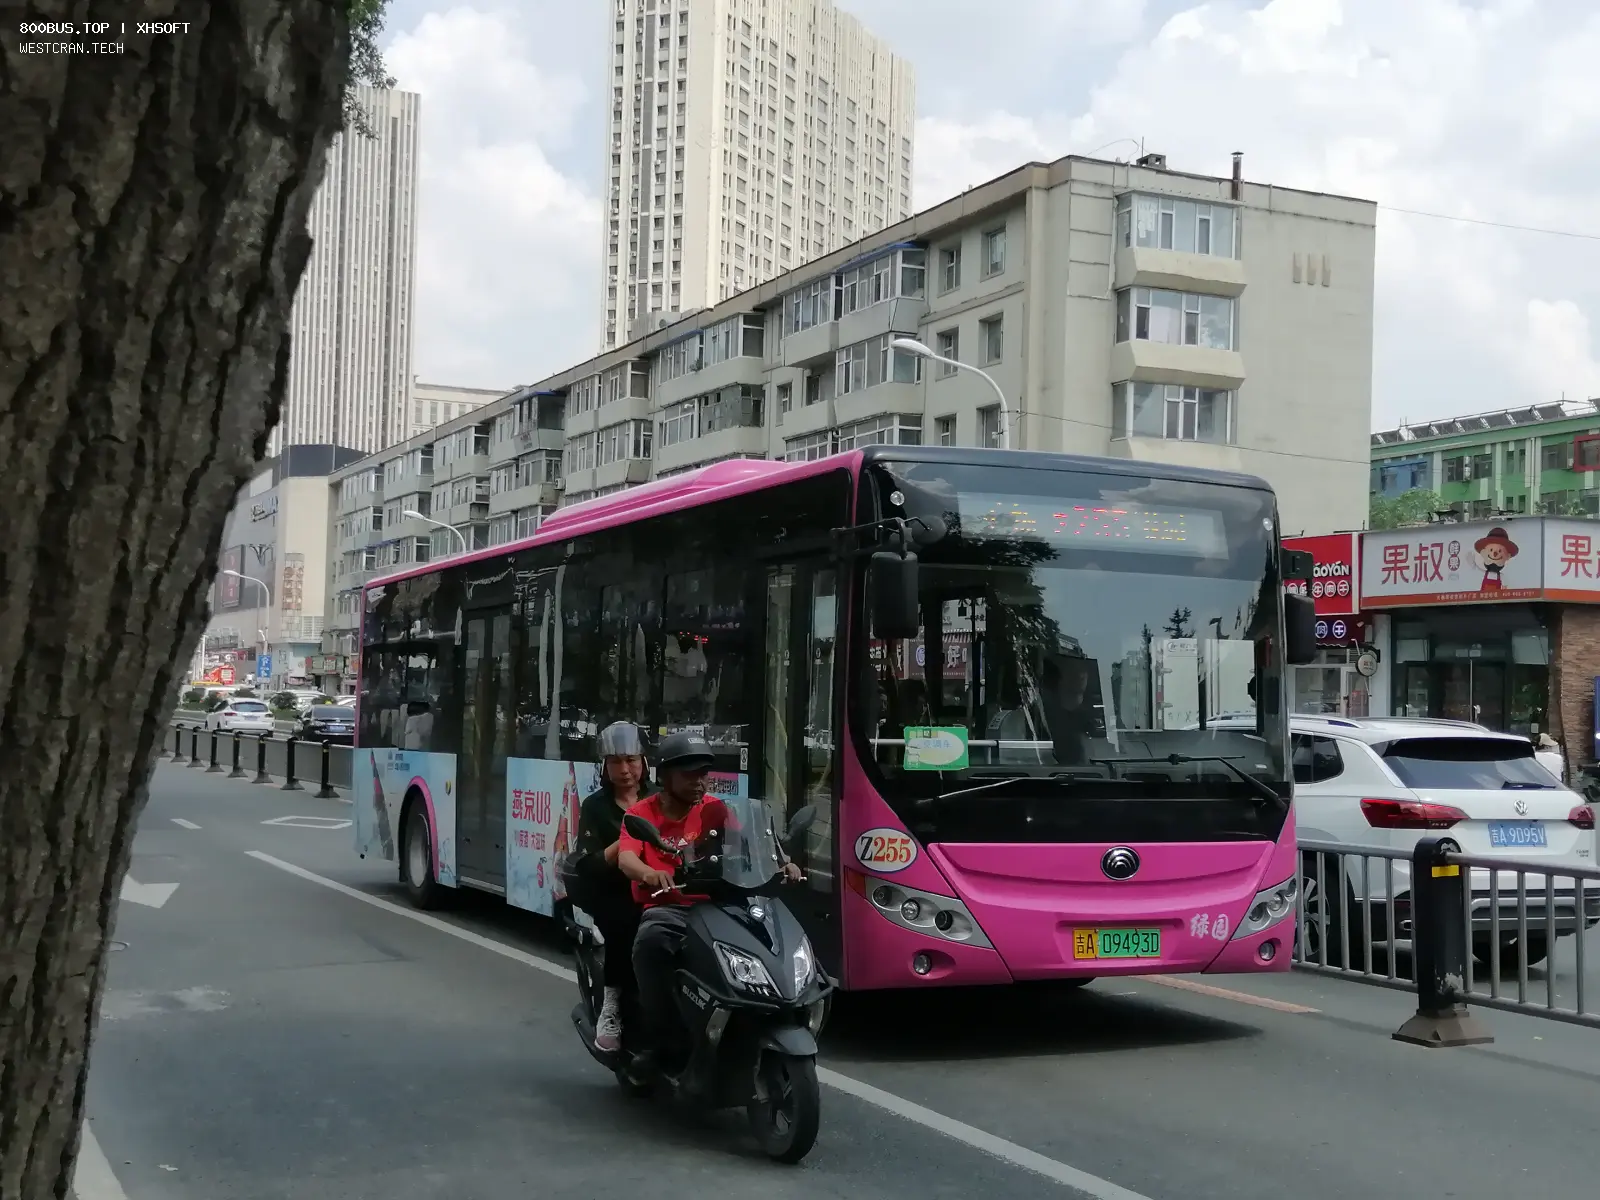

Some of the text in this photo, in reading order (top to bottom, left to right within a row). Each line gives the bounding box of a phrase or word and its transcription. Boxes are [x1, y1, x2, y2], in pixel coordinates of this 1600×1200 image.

[1381, 543, 1444, 584] 果叔
[1561, 534, 1600, 578] 果
[512, 789, 551, 825] 燕京U8
[860, 836, 911, 863] Z255
[1190, 913, 1229, 940] 绿园
